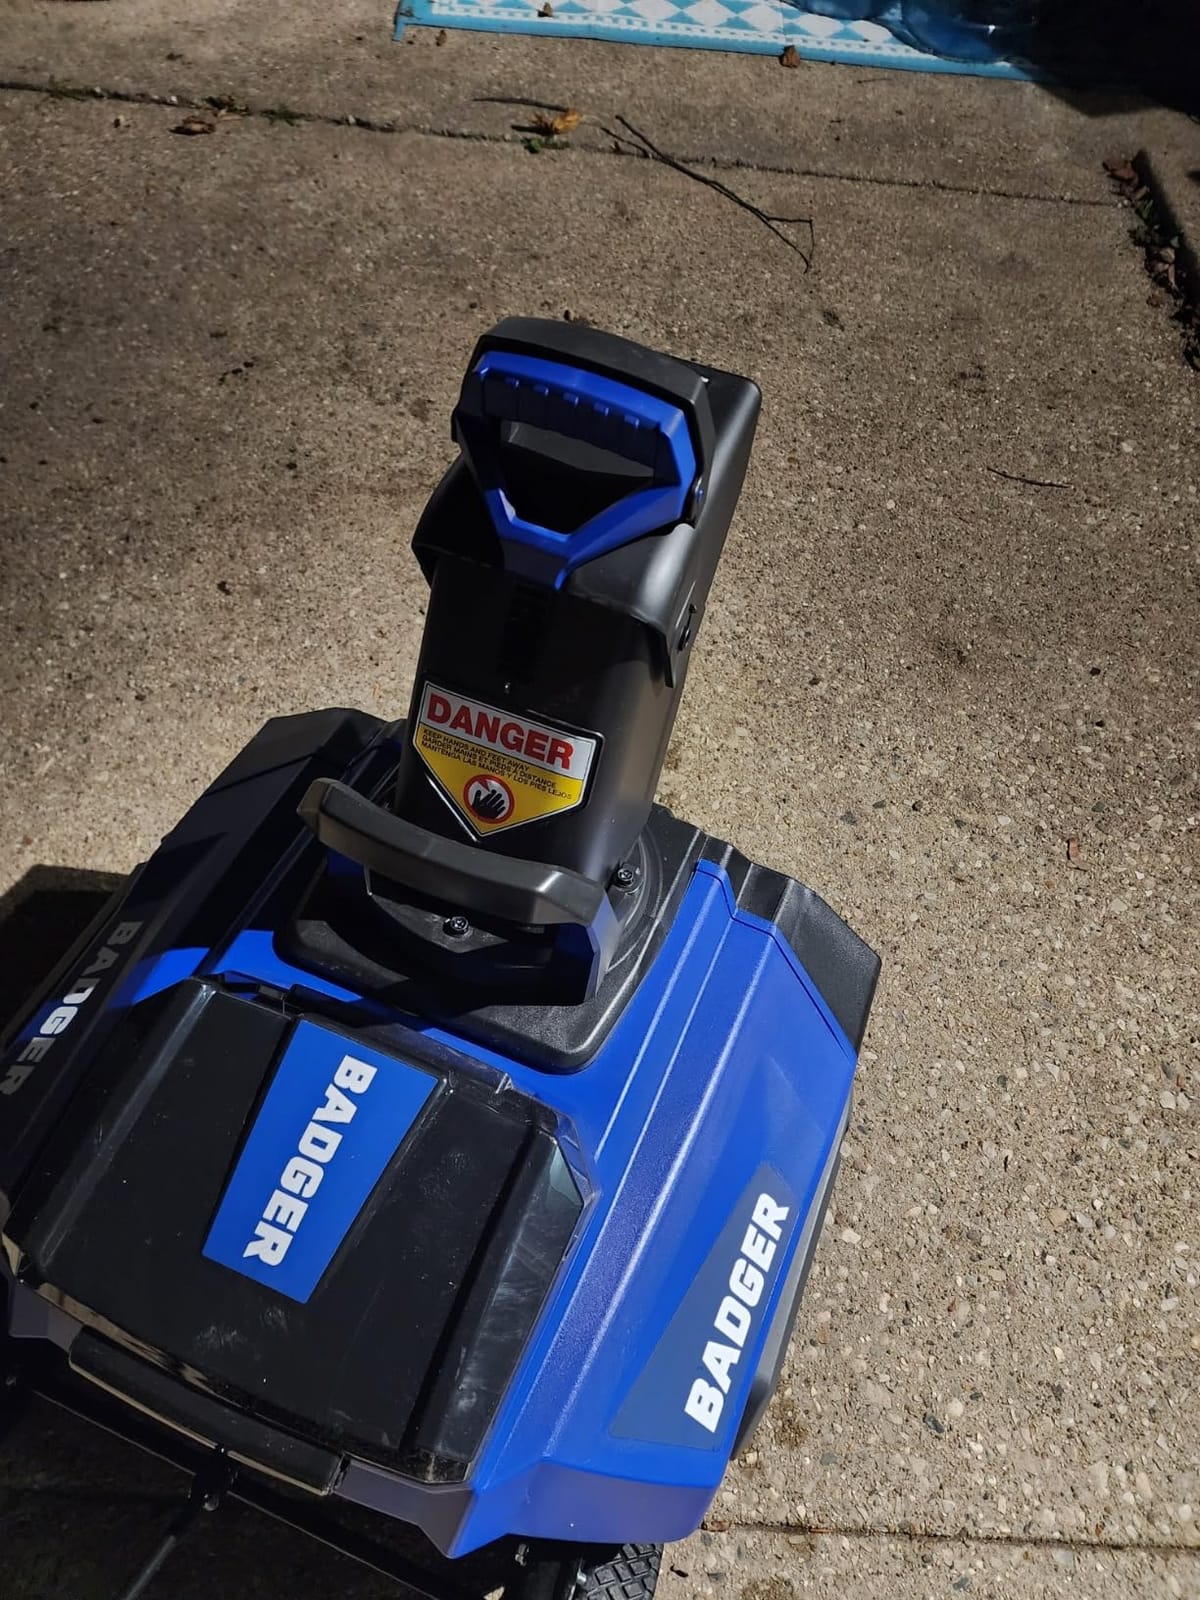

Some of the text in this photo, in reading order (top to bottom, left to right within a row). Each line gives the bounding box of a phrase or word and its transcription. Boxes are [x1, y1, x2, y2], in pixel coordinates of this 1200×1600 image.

[421, 740, 461, 761] MANTENGA
[463, 757, 477, 766] LAS
[478, 762, 505, 777] MANOS
[513, 775, 528, 785] LOS
[529, 781, 546, 792] PIES
[547, 788, 572, 800] LEJOS
[422, 734, 452, 750] GARDER
[453, 746, 478, 760] MAINS
[489, 760, 511, 772] PIEDS
[519, 771, 557, 788] DISTANCE
[423, 729, 530, 771] KEEP HANDS AND FEET AWAY
[426, 693, 574, 770] DANGER
[0, 921, 145, 1096] BADGER
[242, 1054, 378, 1267] BADGER
[684, 1193, 790, 1433] BADGER
